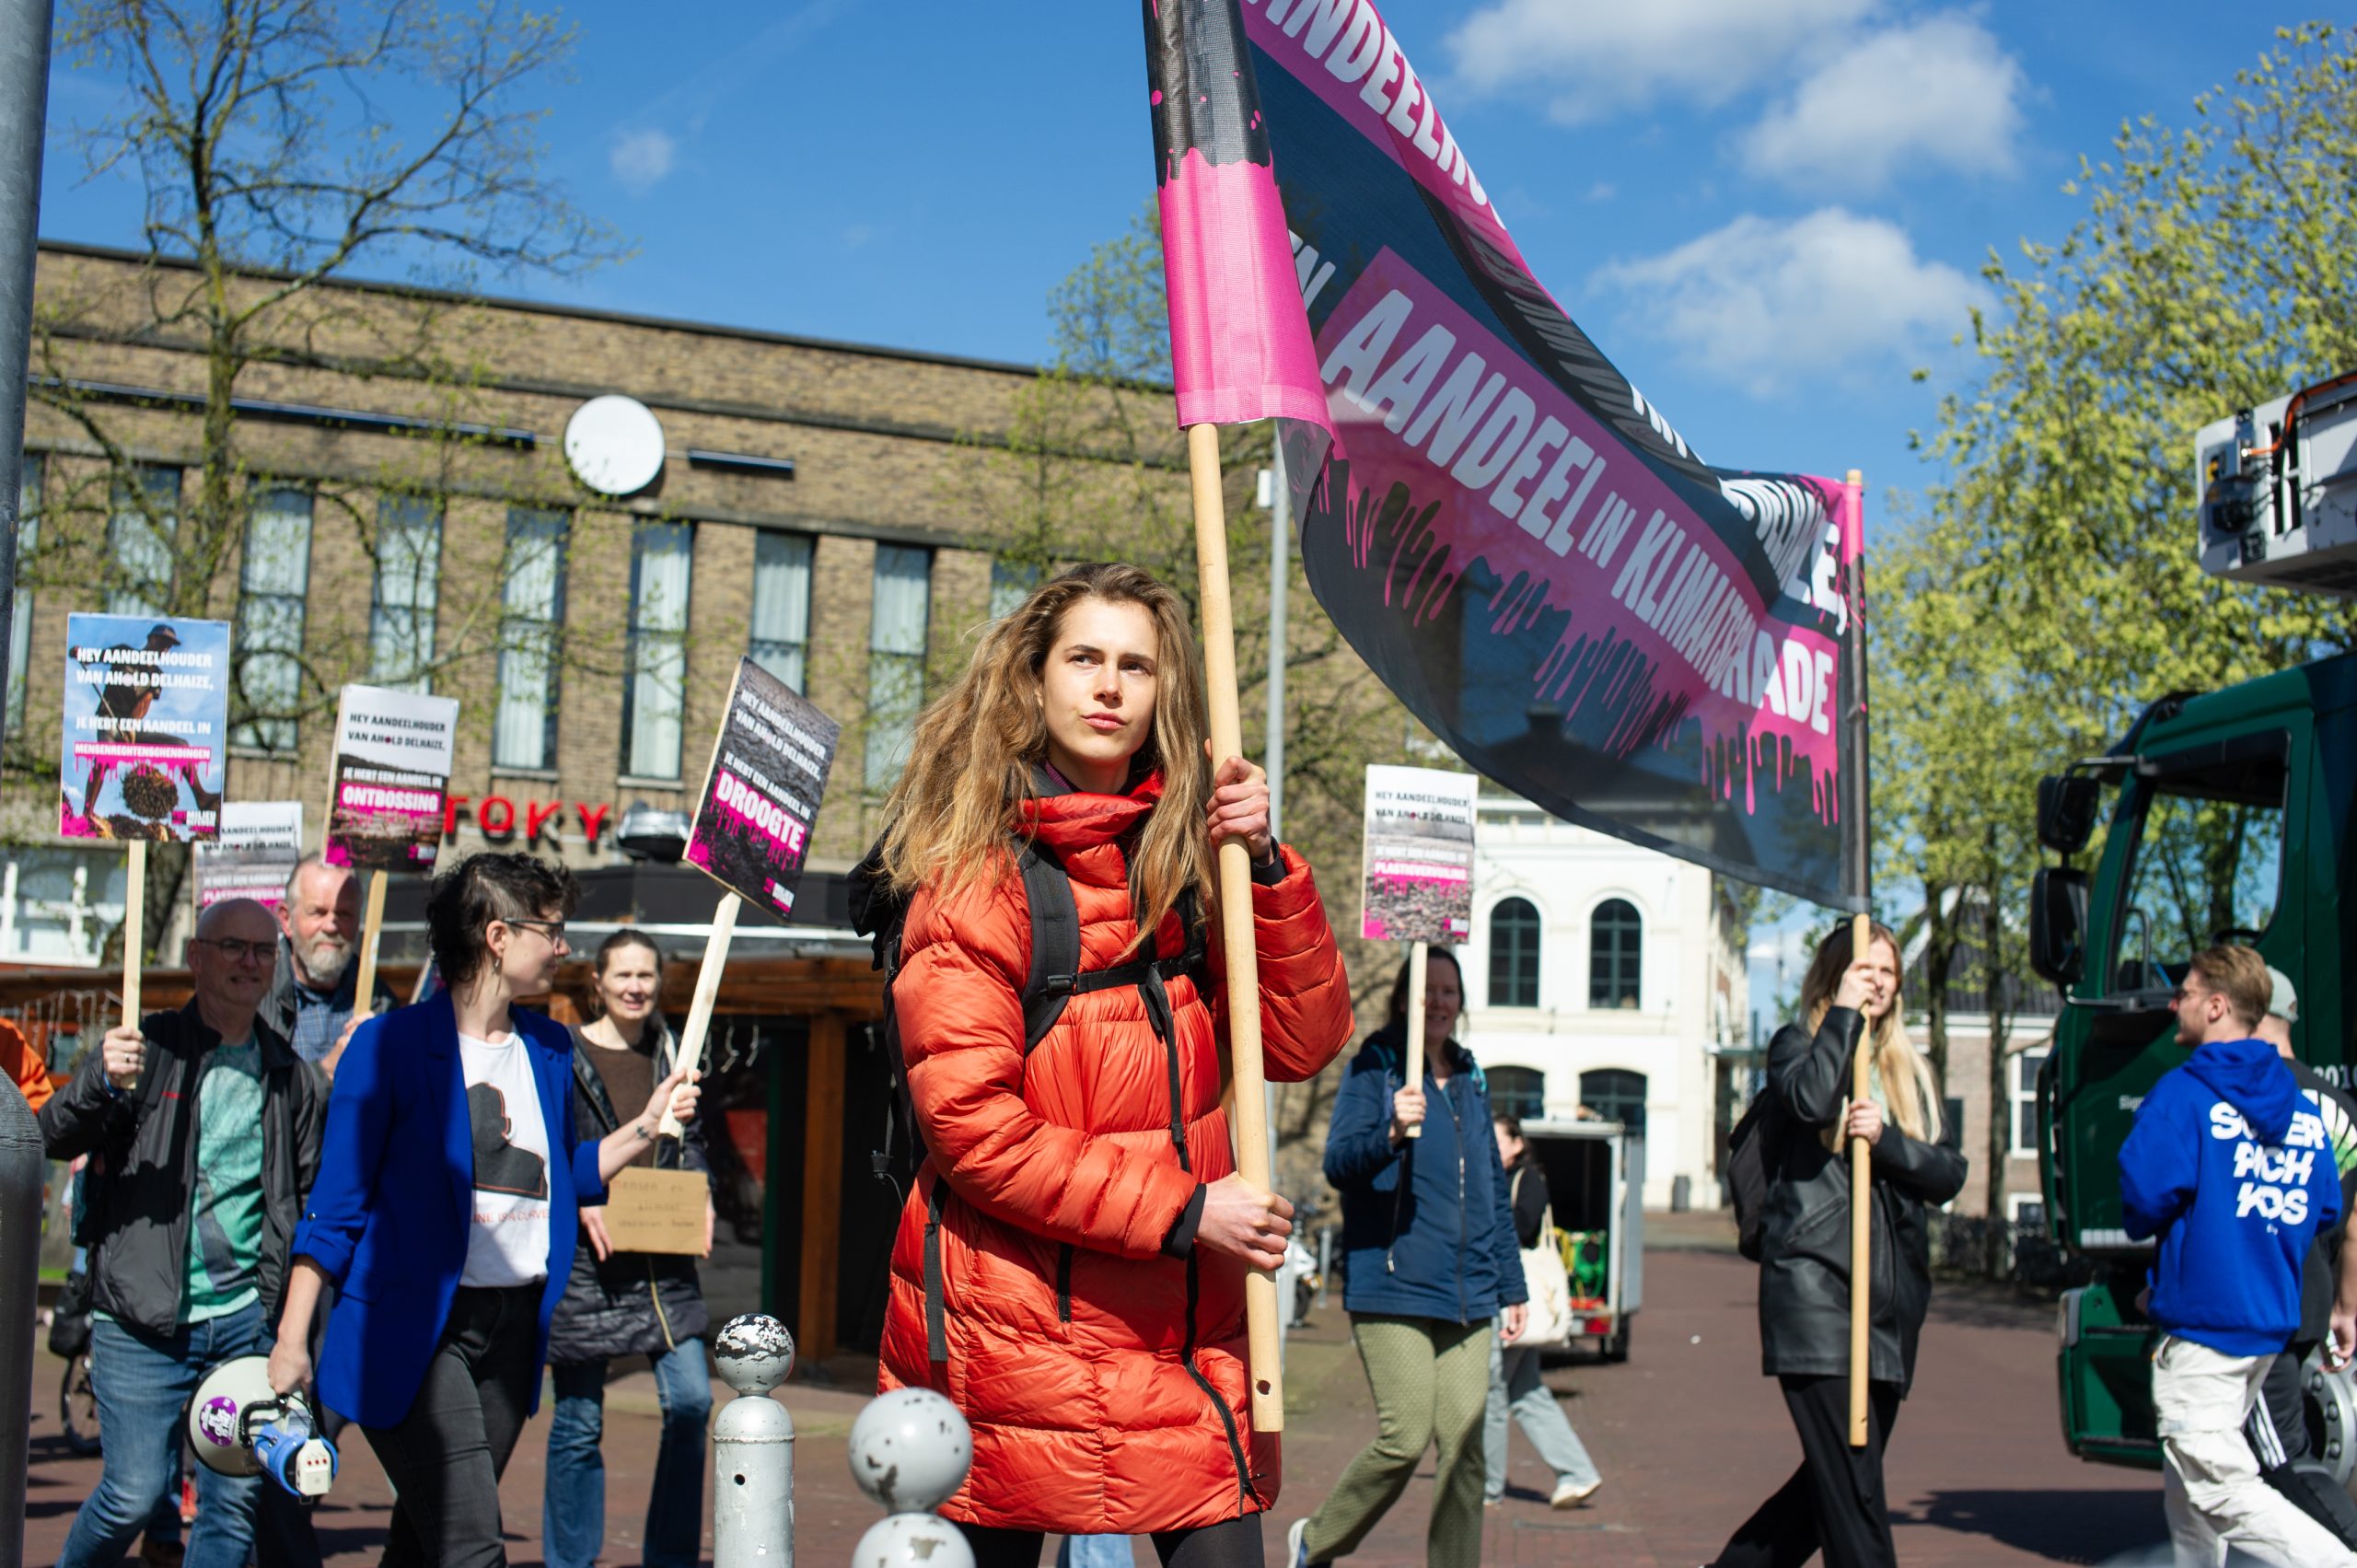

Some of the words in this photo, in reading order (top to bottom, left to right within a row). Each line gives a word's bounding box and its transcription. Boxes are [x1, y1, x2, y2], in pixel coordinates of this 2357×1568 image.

[1319, 289, 1607, 557] AANDEEL
[1578, 491, 1637, 569] IN
[76, 647, 102, 663] HEY
[103, 648, 212, 668] AANDEELHOUDER
[76, 668, 103, 684] VAN
[150, 672, 214, 691] DELHAIZE,
[75, 715, 87, 730] JE
[89, 716, 118, 730] HEBT
[120, 717, 142, 732] EEN
[143, 719, 195, 734] AANDEEL
[197, 721, 211, 735] IN
[350, 714, 368, 723] HEY
[371, 716, 446, 732] AANDEELHOUDER
[736, 708, 756, 731] VAN
[741, 689, 759, 709] HEY
[757, 702, 826, 761] AANDEELHOUDER
[348, 731, 368, 740] VAN
[724, 750, 735, 766] JE
[343, 785, 439, 812] ONTBOSSING
[445, 796, 622, 841] TOKY
[715, 772, 806, 853] DROOGTE
[2210, 1101, 2326, 1150] SER
